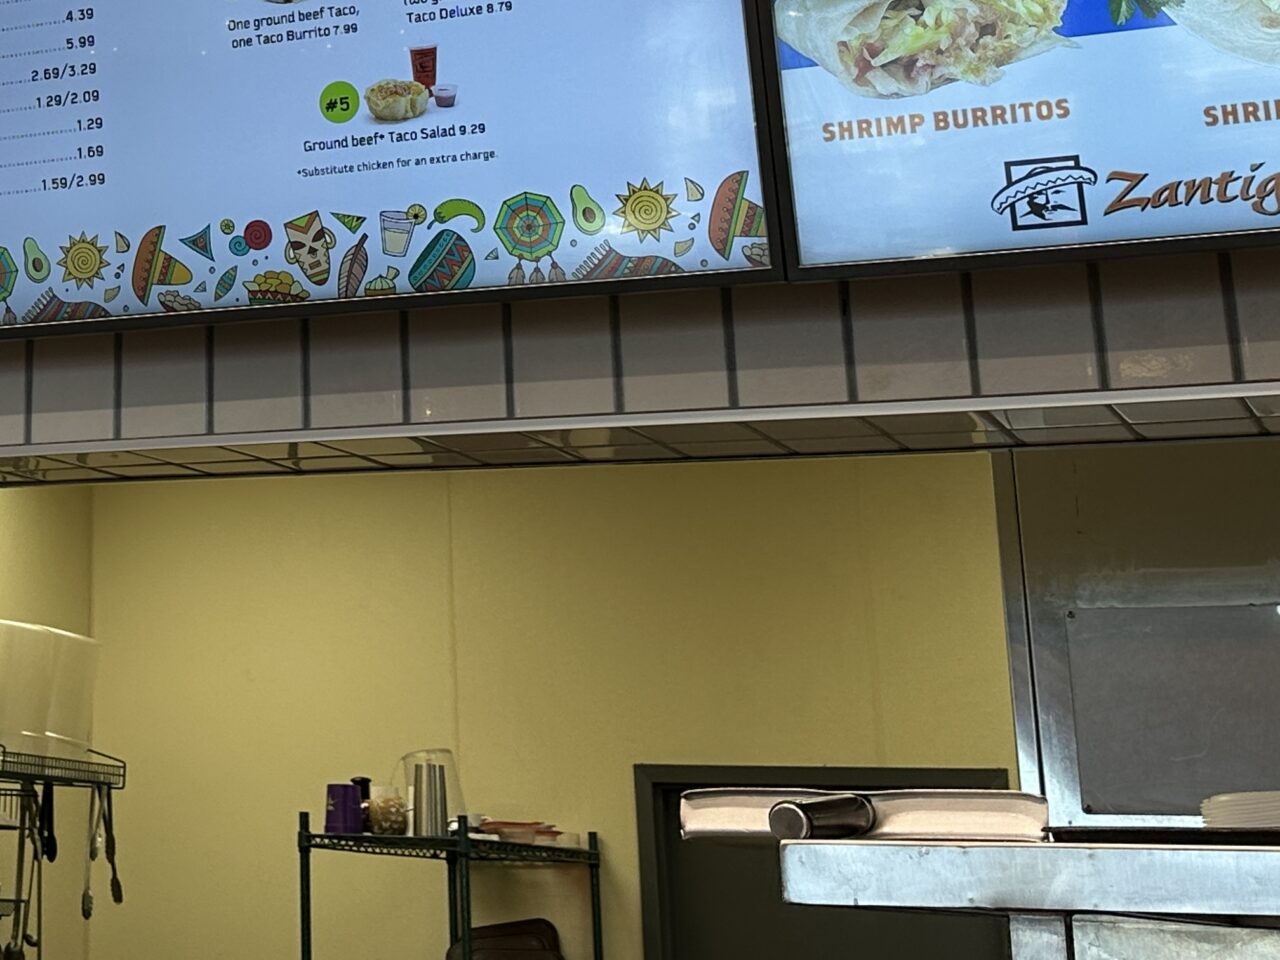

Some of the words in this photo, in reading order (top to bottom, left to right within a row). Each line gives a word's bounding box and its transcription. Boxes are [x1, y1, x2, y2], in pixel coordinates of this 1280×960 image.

[65, 8, 94, 23] 4.39
[227, 19, 250, 31] One
[253, 11, 295, 30] ground
[297, 6, 324, 21] beef
[326, 5, 359, 17] Taco,
[406, 3, 437, 22] Taco
[439, 5, 482, 19] Deluxe
[486, 0, 512, 13] 8.79
[66, 34, 94, 49] 5.99
[231, 37, 252, 48] one
[255, 33, 283, 44] Taco
[286, 26, 330, 41] Burrito
[332, 22, 357, 34] 7.99
[30, 62, 97, 83] 2.69/3.29
[325, 96, 349, 112] #5
[1203, 97, 1280, 128] SHRI
[822, 111, 926, 143] SHRIMP
[933, 98, 1072, 133] BURRITOS
[303, 136, 348, 151] Ground
[387, 130, 417, 142] Taco
[420, 124, 456, 139] Salad
[458, 123, 485, 135] 9.29
[76, 144, 104, 160] 1.69
[356, 160, 394, 171] chicken
[396, 157, 411, 167] for
[414, 157, 426, 165] an
[429, 154, 457, 164] extra
[459, 150, 495, 161] charge.
